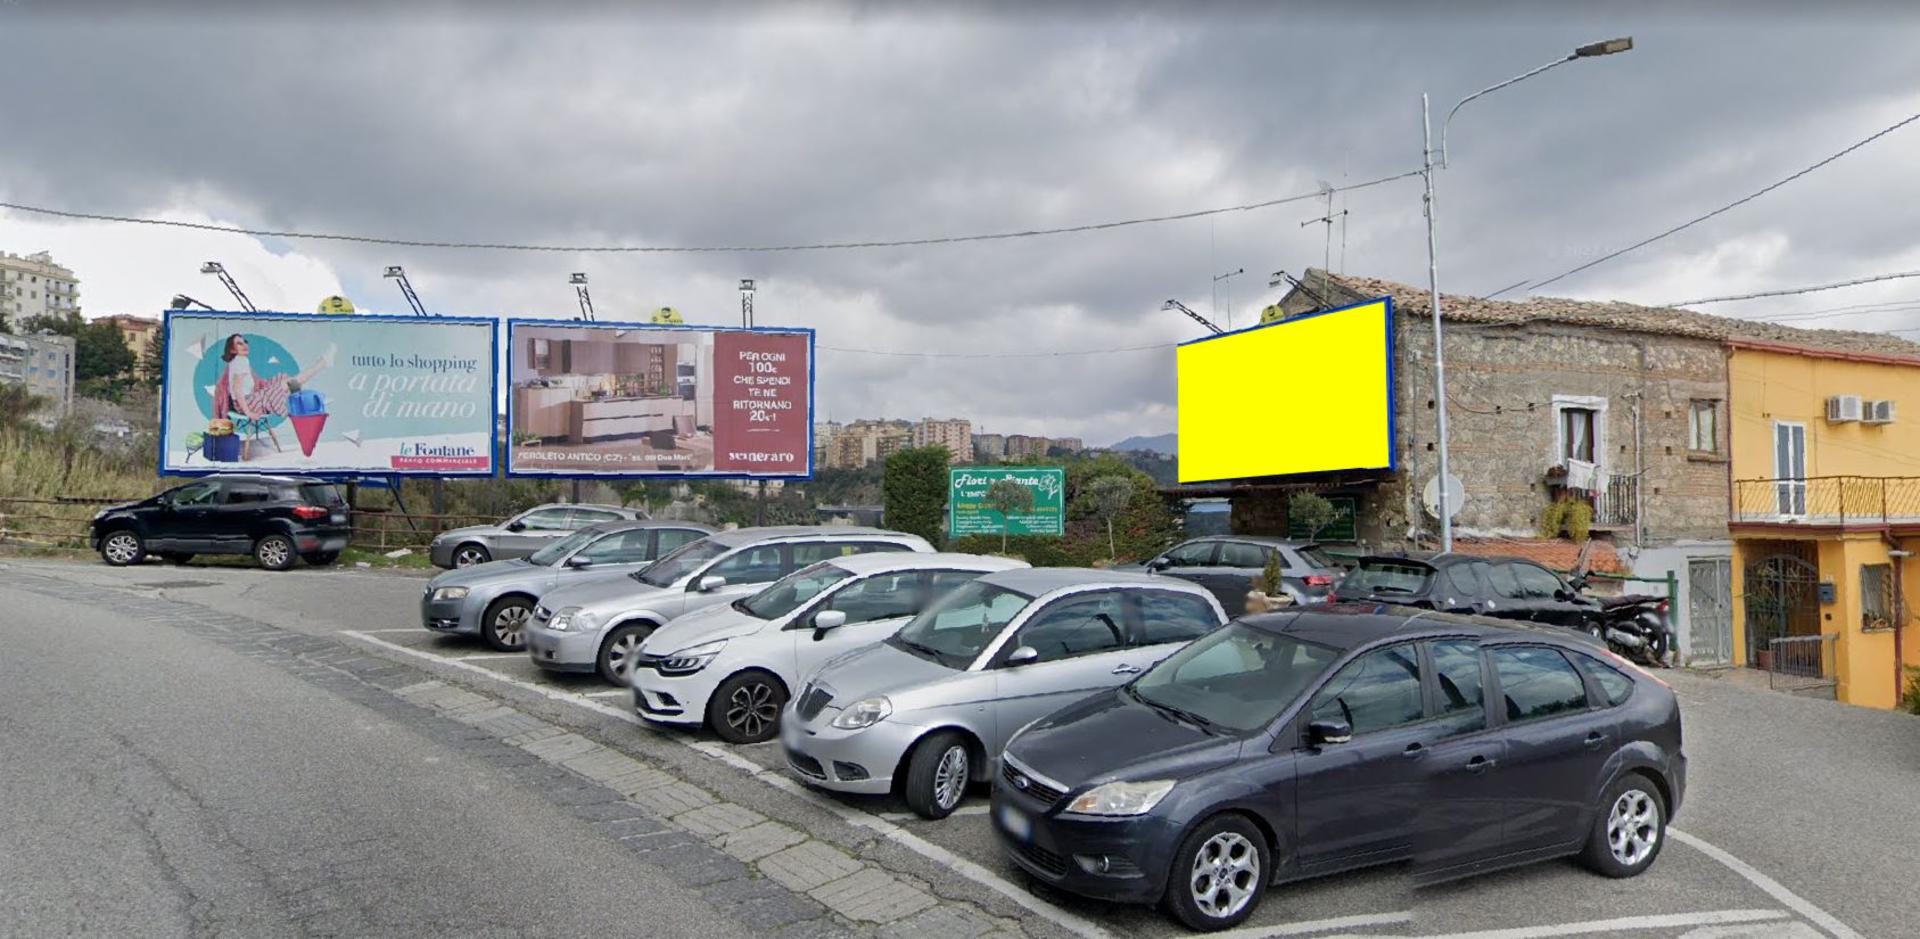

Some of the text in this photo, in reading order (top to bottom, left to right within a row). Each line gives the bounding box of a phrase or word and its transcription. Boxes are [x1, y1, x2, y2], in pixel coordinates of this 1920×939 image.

[739, 352, 786, 362] PER OGNI
[352, 353, 478, 373] tutto lo shopping
[733, 375, 791, 386] CHE SPENDI
[348, 373, 478, 400] a portata
[748, 388, 777, 398] TE NE
[362, 391, 476, 418] di mano
[733, 400, 792, 410] RITORNANO
[415, 442, 475, 457] Fontane
[567, 452, 602, 461] ANTICO
